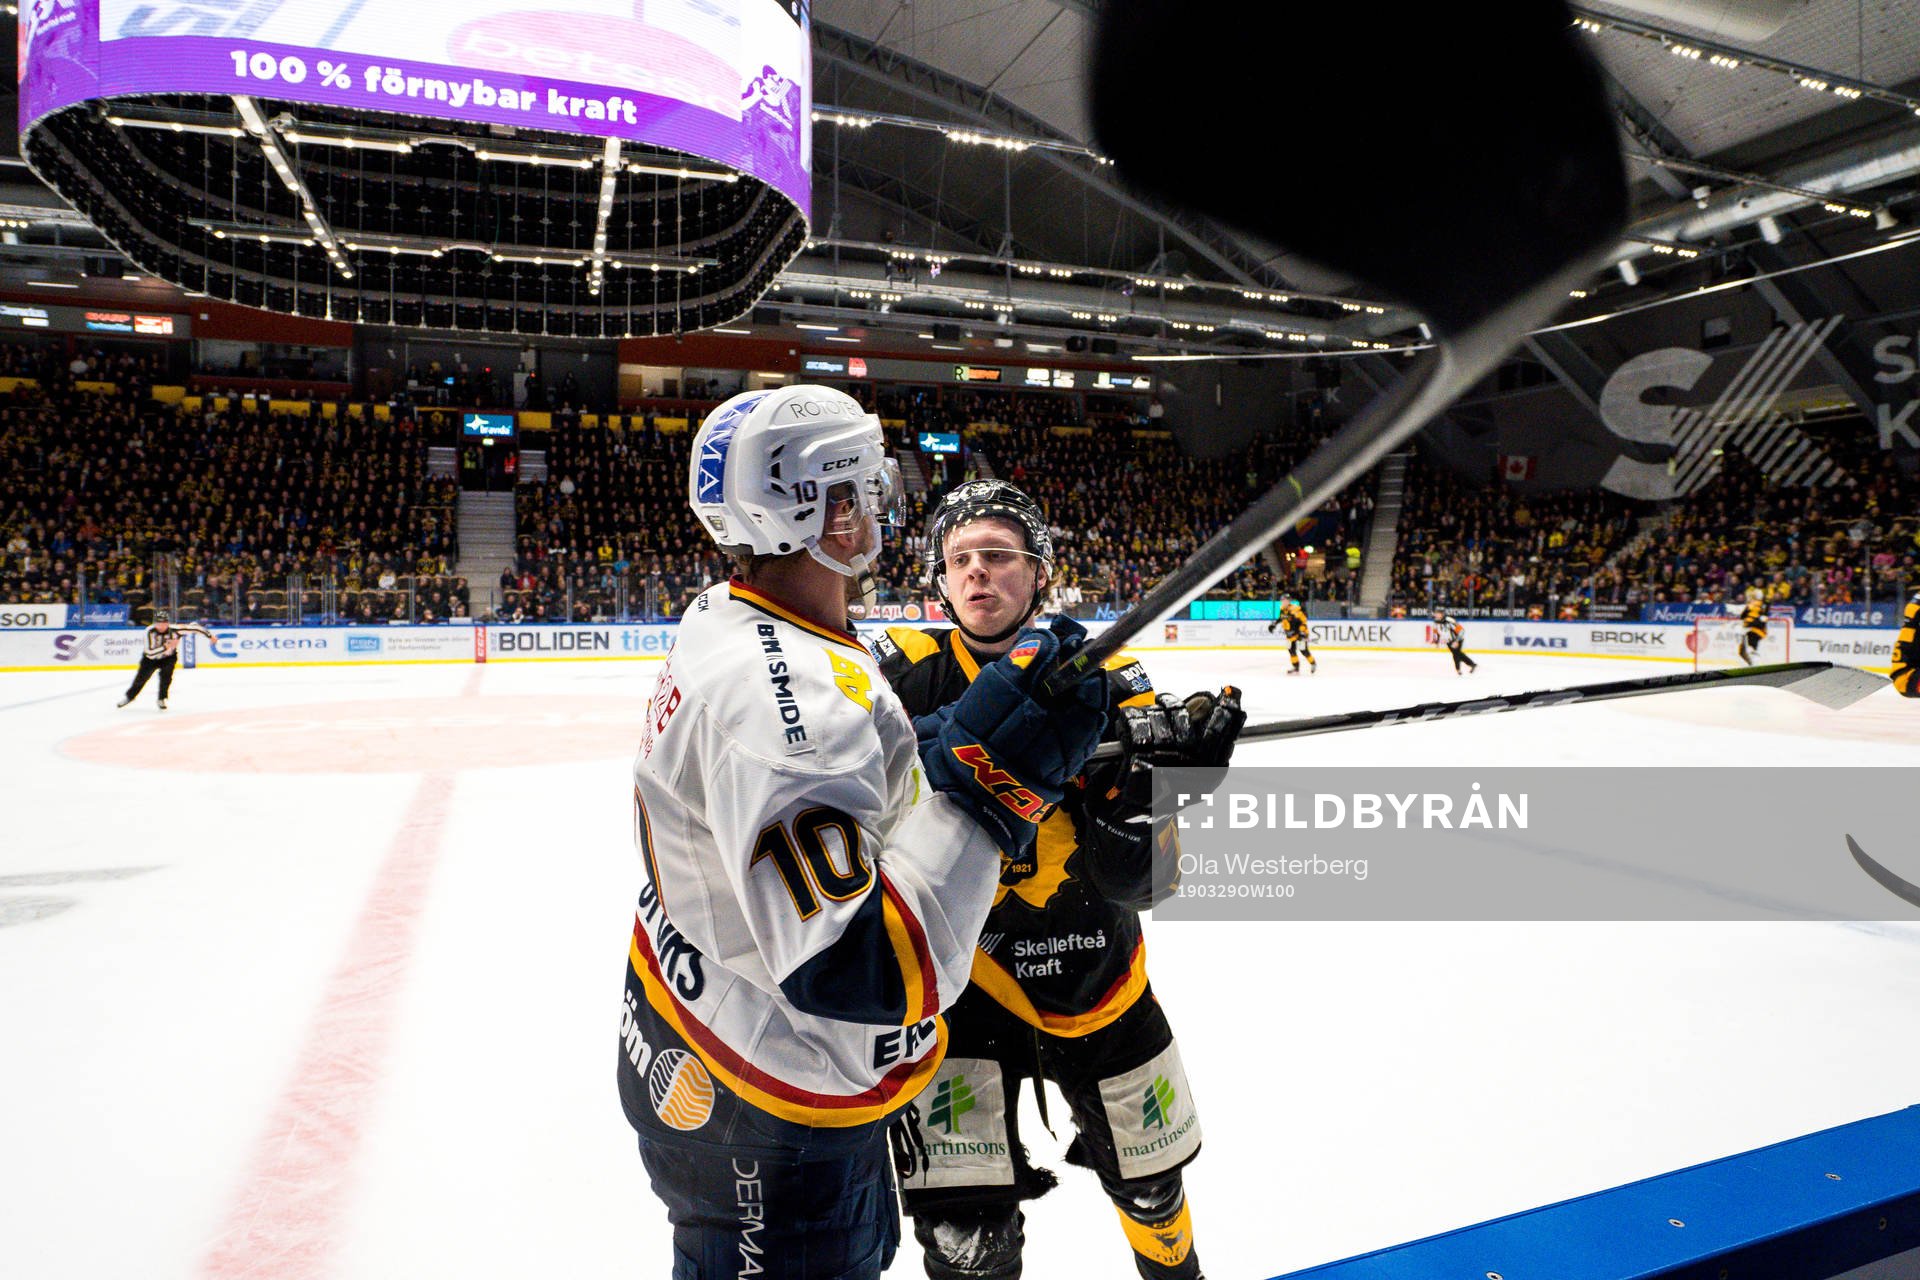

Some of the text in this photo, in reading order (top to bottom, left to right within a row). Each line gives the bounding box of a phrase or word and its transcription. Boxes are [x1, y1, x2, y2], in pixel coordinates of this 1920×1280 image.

[230, 50, 638, 125] 100 % förnybar kraft
[822, 455, 860, 472] CCM
[789, 479, 819, 504] 10
[1802, 606, 1883, 626] 4Sign.se
[240, 636, 328, 650] extena
[499, 631, 610, 652] BOLIDEN
[1853, 641, 1891, 656] bilen
[750, 806, 873, 923] 10
[1011, 863, 1033, 874] 1921
[1014, 930, 1106, 957] Skellefteå
[1015, 958, 1063, 979] Kraft
[1122, 1111, 1197, 1159] martinsons
[924, 1138, 1006, 1158] artinsons
[732, 1157, 765, 1280] DERMA
